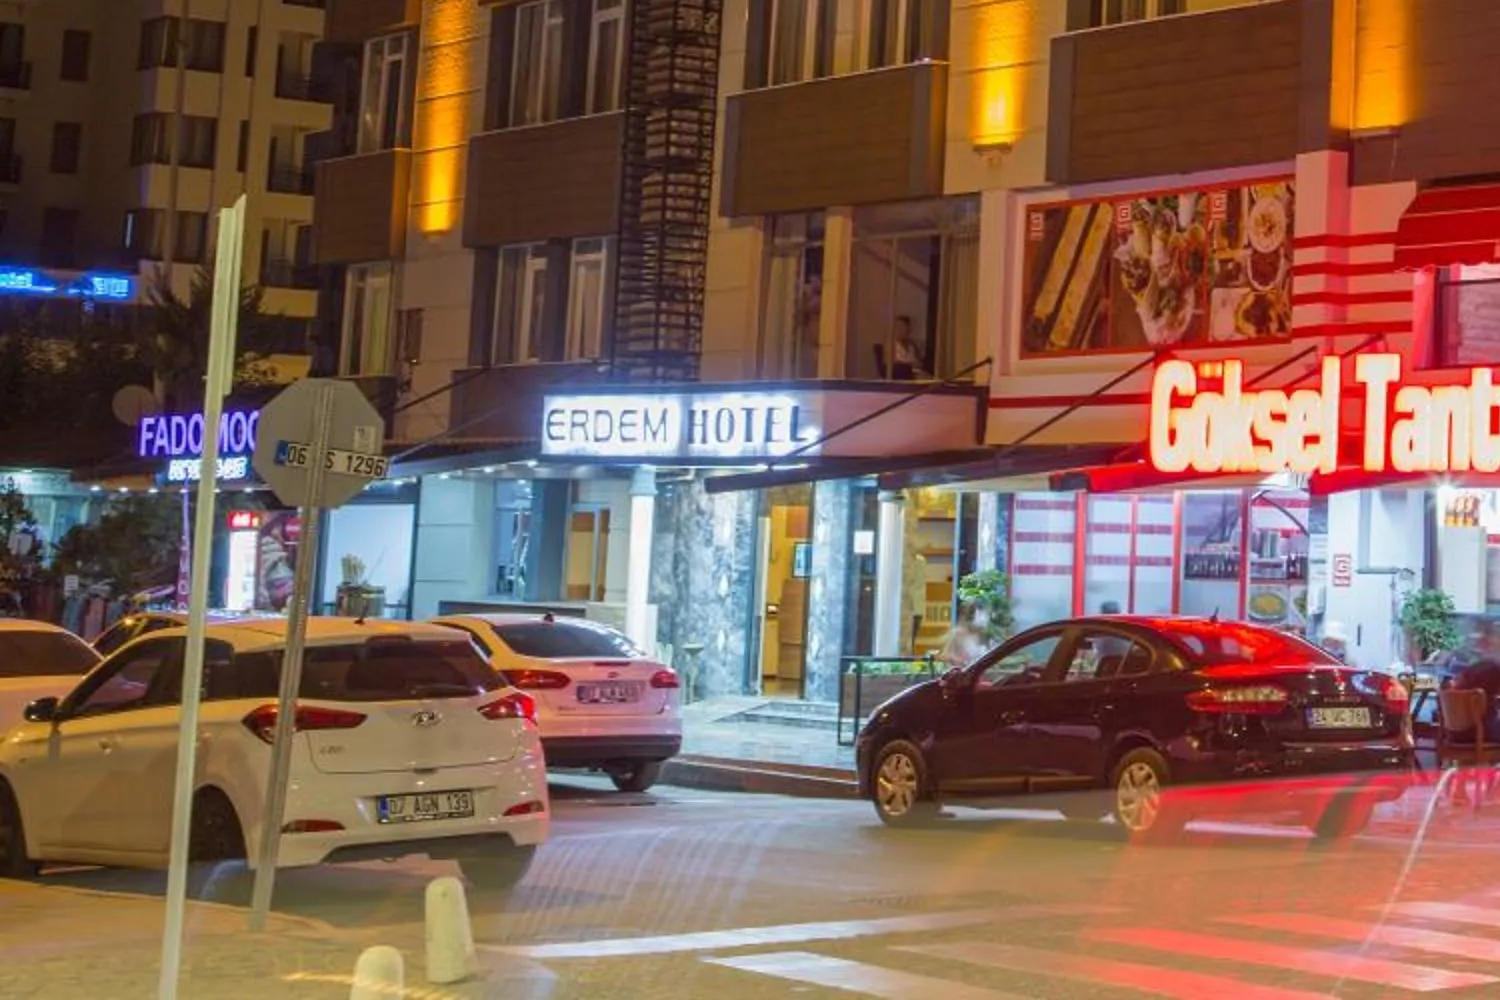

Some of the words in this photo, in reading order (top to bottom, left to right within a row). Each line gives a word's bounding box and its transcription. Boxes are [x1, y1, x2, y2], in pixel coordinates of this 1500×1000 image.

[546, 407, 669, 444] ERDEM
[687, 404, 809, 445] HOTEL
[1150, 356, 1340, 475] Göksel
[286, 445, 307, 465] 06
[347, 454, 385, 477] 1296
